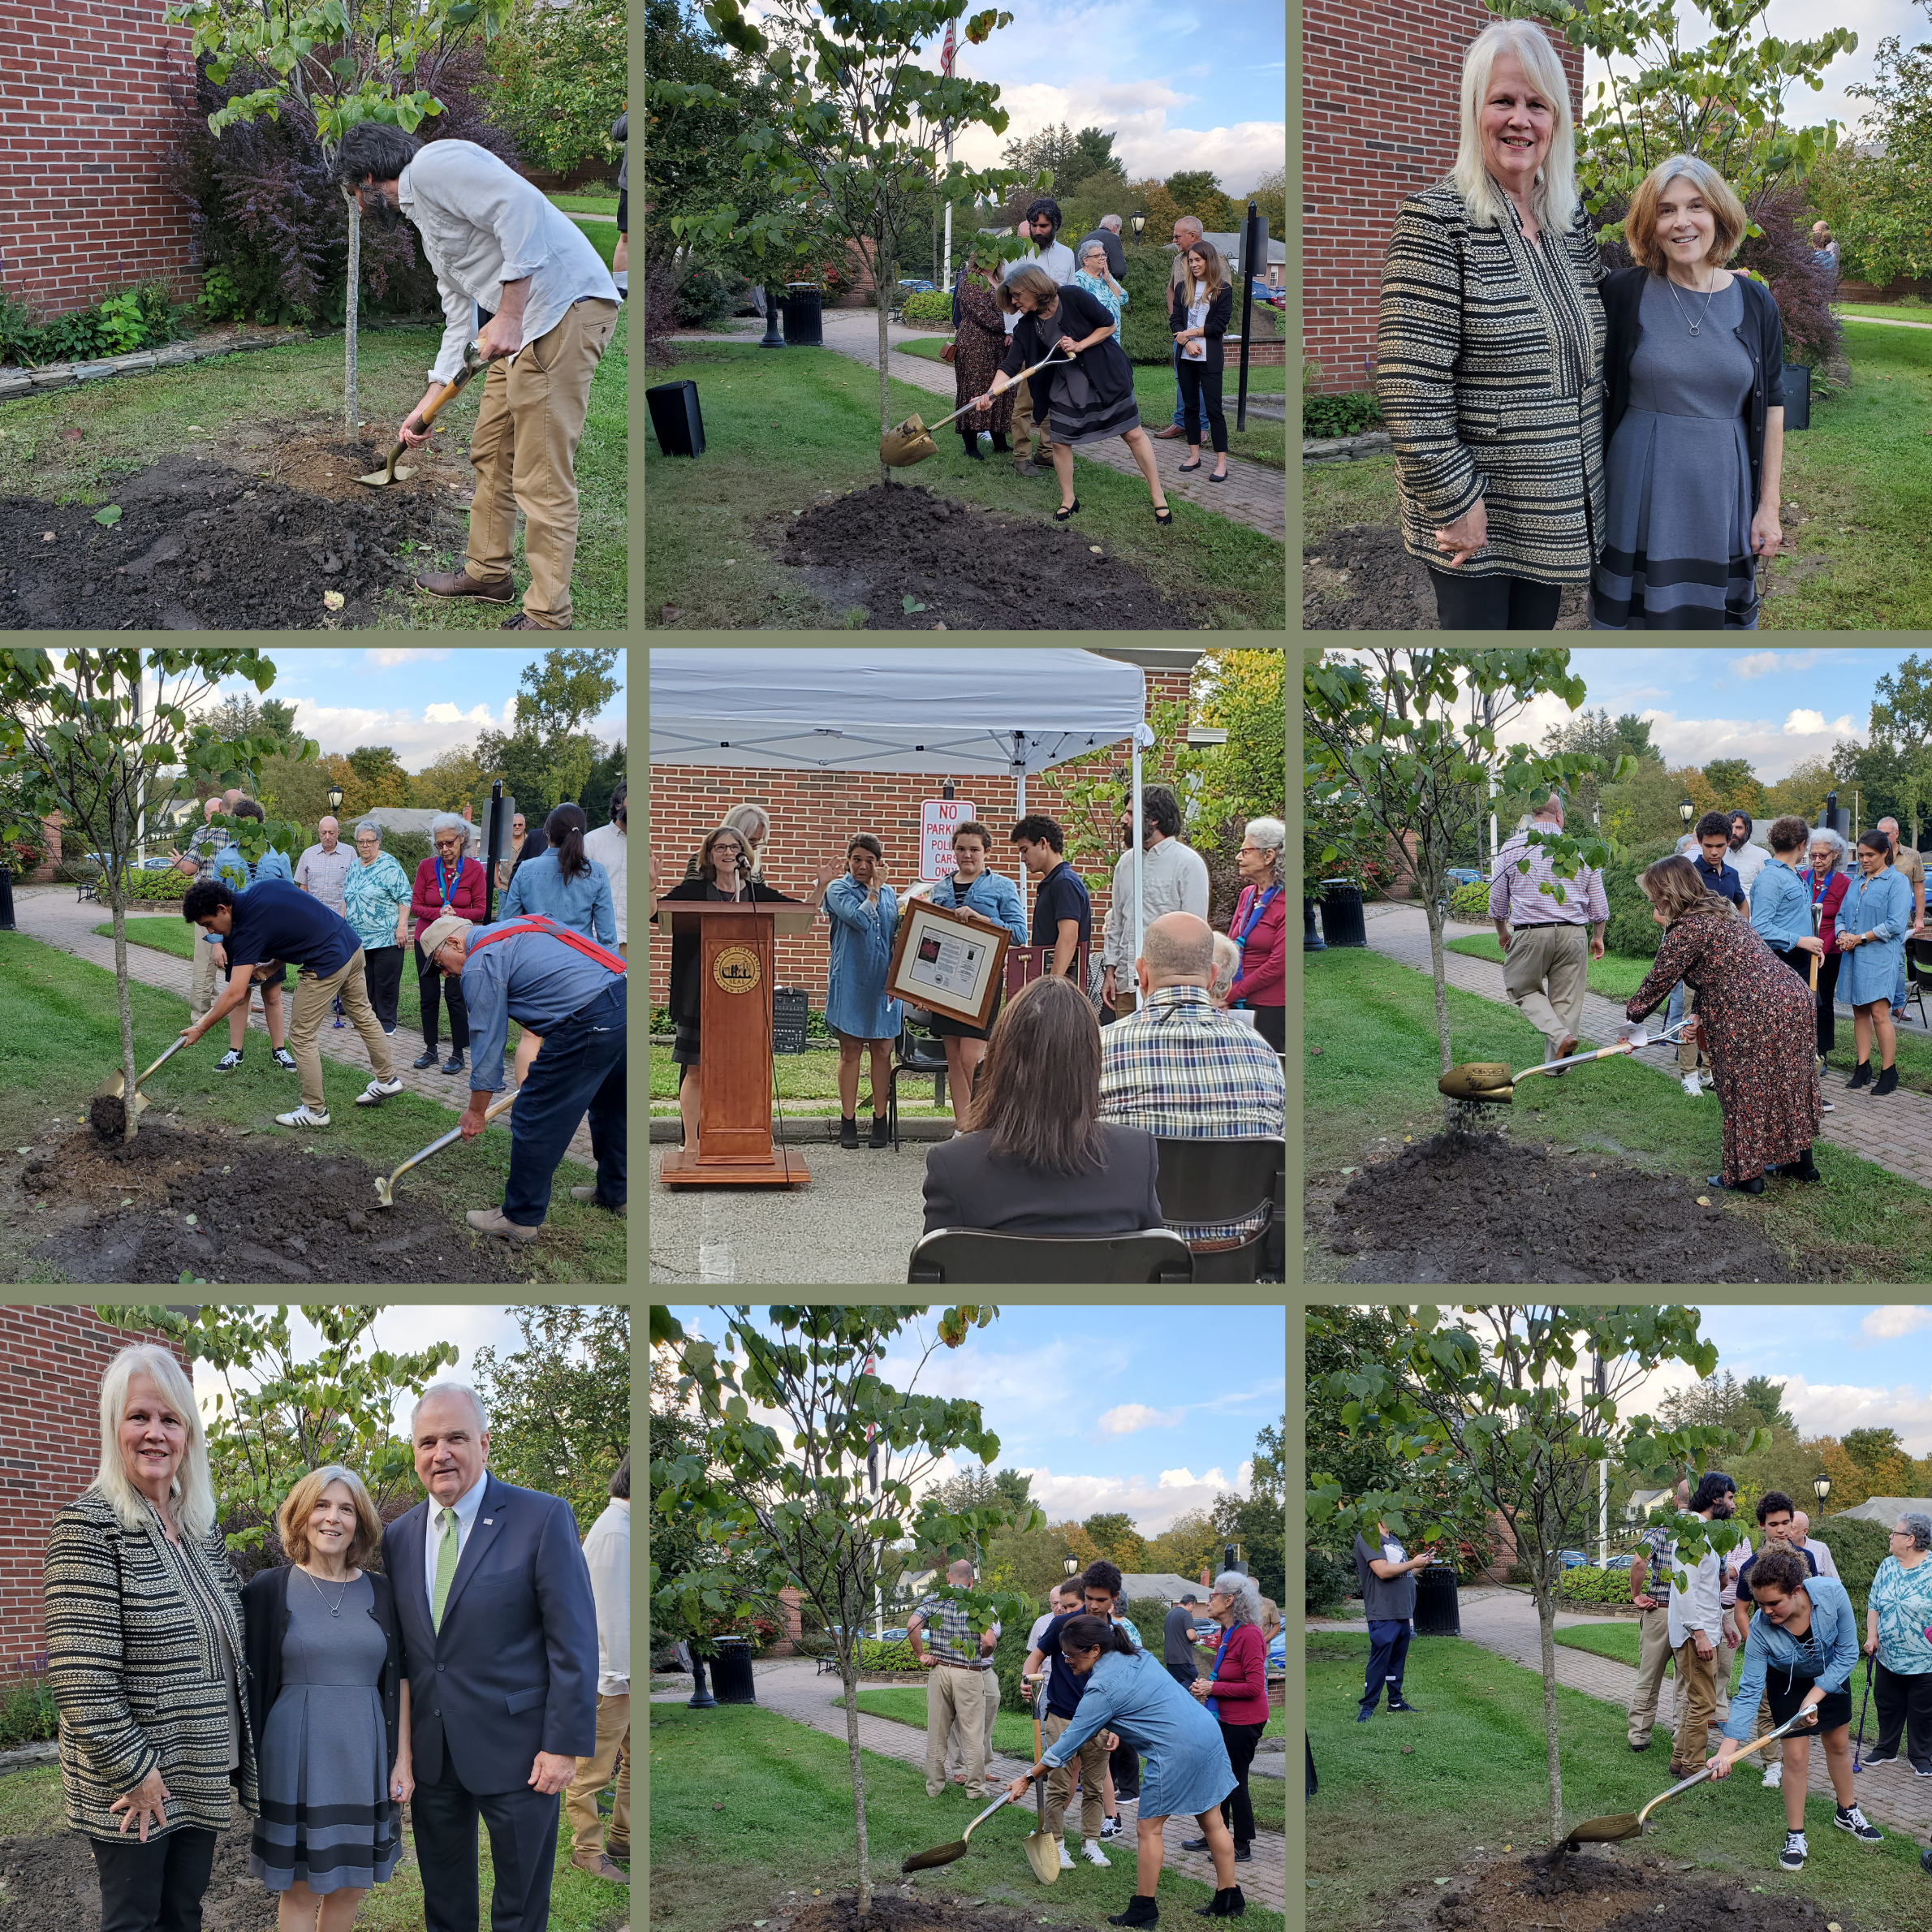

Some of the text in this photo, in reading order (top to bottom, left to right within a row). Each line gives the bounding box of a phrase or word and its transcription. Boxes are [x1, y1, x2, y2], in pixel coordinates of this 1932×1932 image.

[939, 804, 957, 819] NO
[926, 823, 955, 835] PARKI
[931, 839, 953, 851] POLI
[934, 853, 957, 865] CARS
